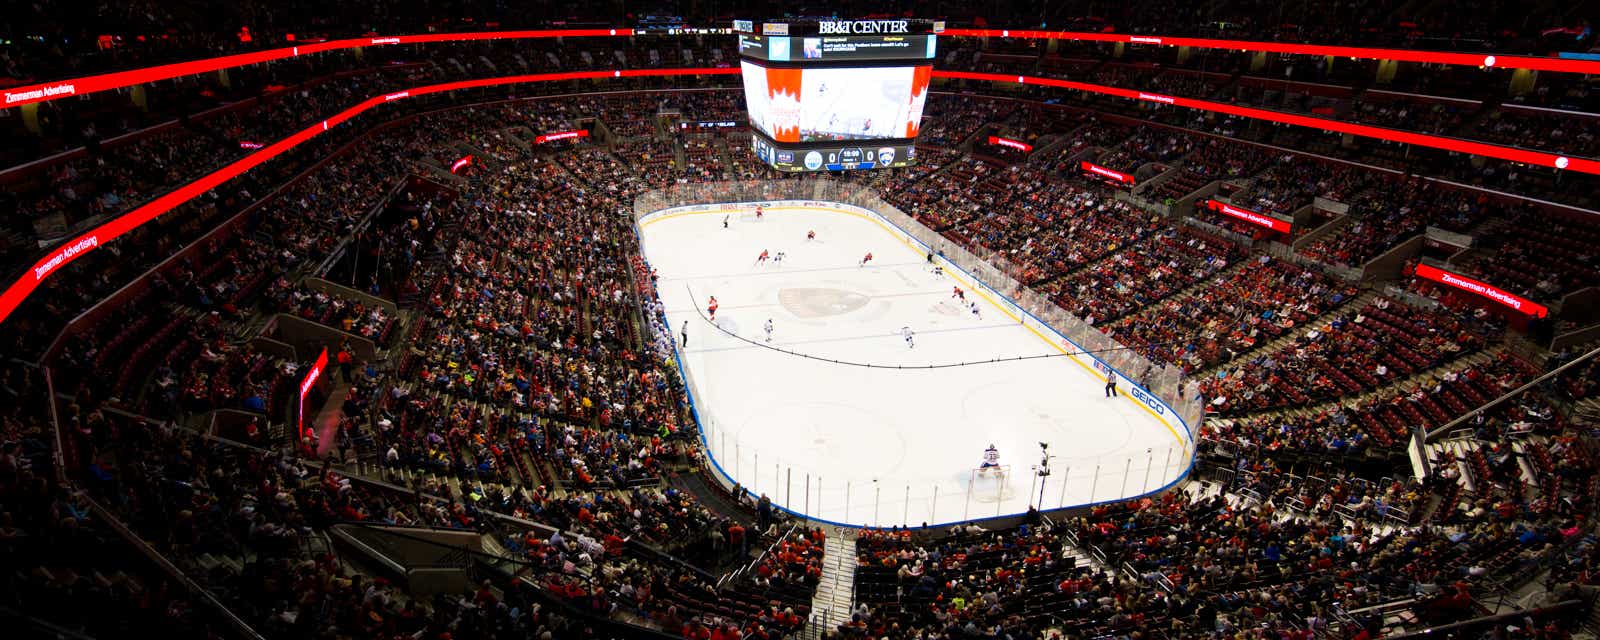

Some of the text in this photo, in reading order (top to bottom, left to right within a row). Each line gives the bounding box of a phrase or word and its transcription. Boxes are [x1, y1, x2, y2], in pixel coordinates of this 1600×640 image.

[819, 20, 908, 34] BB&T CENTER
[1441, 273, 1521, 309] Zimmerman Advertising
[1131, 386, 1165, 415] GEICO
